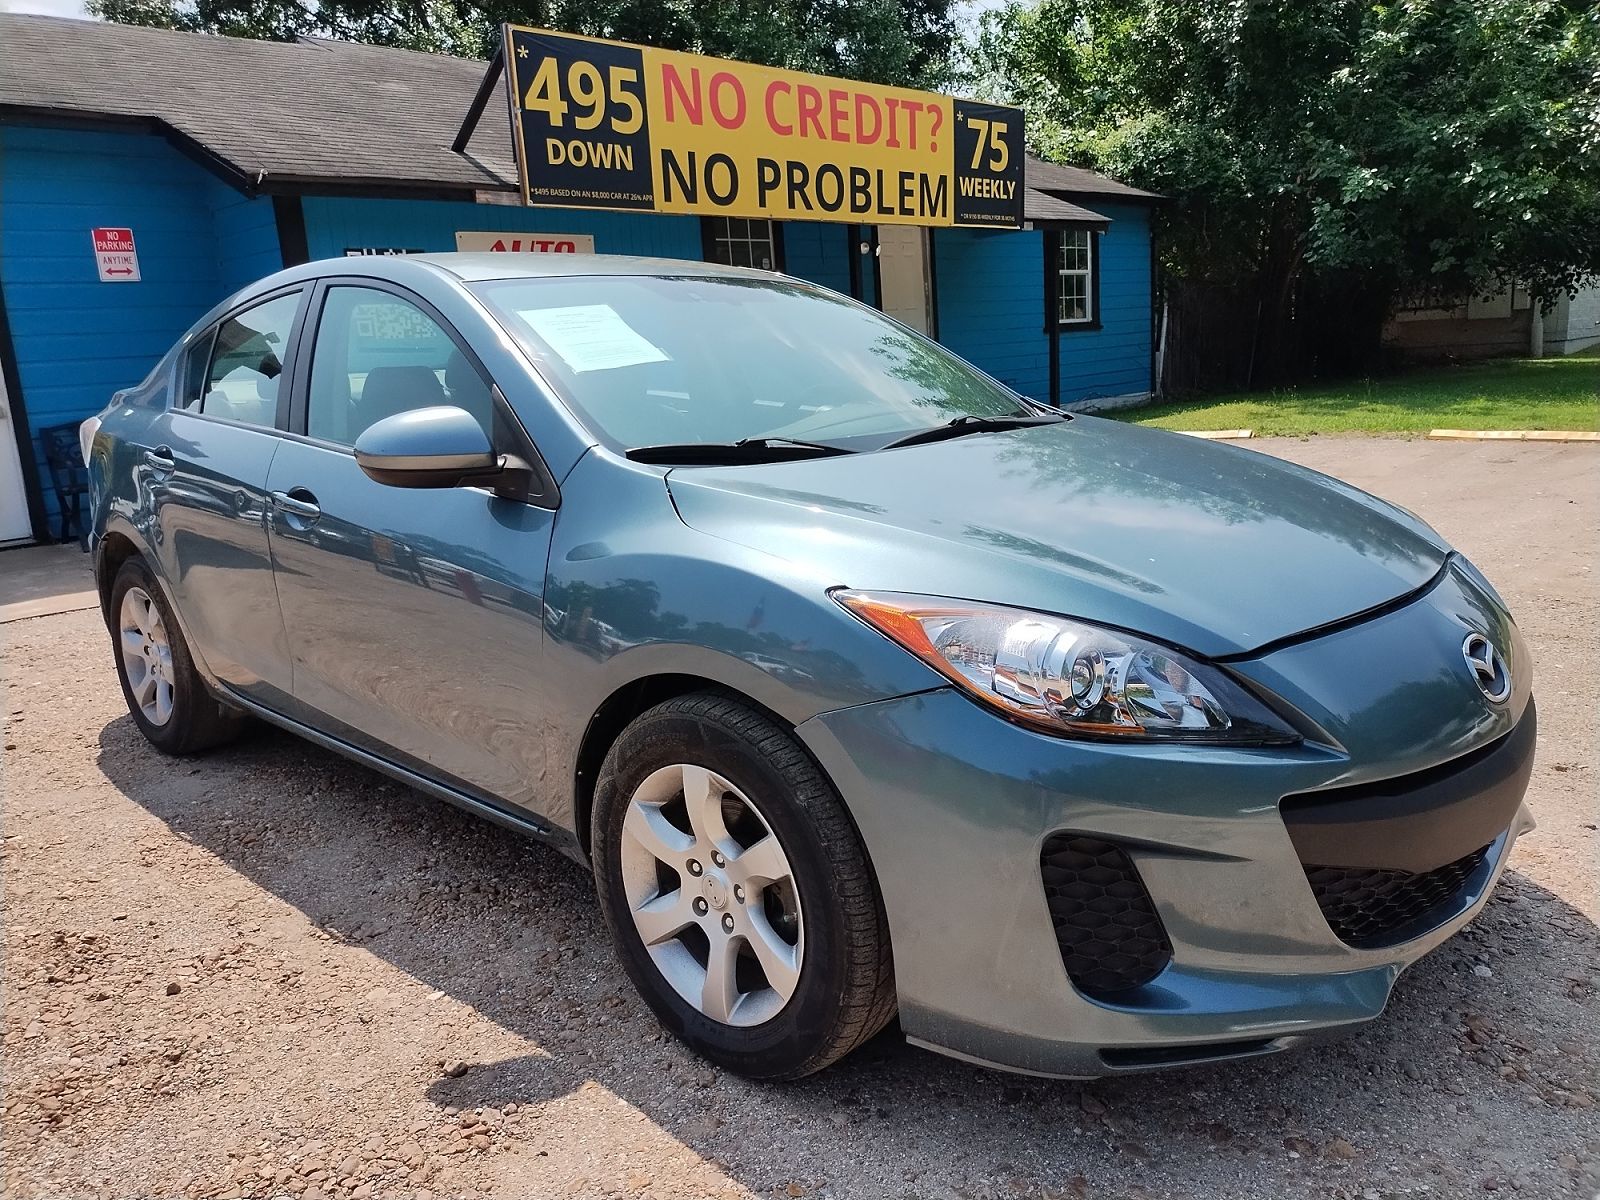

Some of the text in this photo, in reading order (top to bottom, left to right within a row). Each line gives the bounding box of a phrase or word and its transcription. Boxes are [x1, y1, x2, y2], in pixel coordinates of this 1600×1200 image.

[661, 63, 943, 153] NO CREDIT?
[546, 138, 634, 171] DOWN
[660, 148, 948, 218] NO PROBLEM
[959, 176, 1016, 200] WEEKLY
[550, 188, 570, 197] BASED
[571, 189, 581, 198] ON
[581, 190, 591, 198] AN
[591, 191, 610, 199] $8,000
[610, 191, 622, 200] CAR
[622, 192, 630, 200] AT
[106, 231, 119, 241] NO
[97, 241, 133, 251] PARKING
[103, 256, 134, 265] ANYTIME
